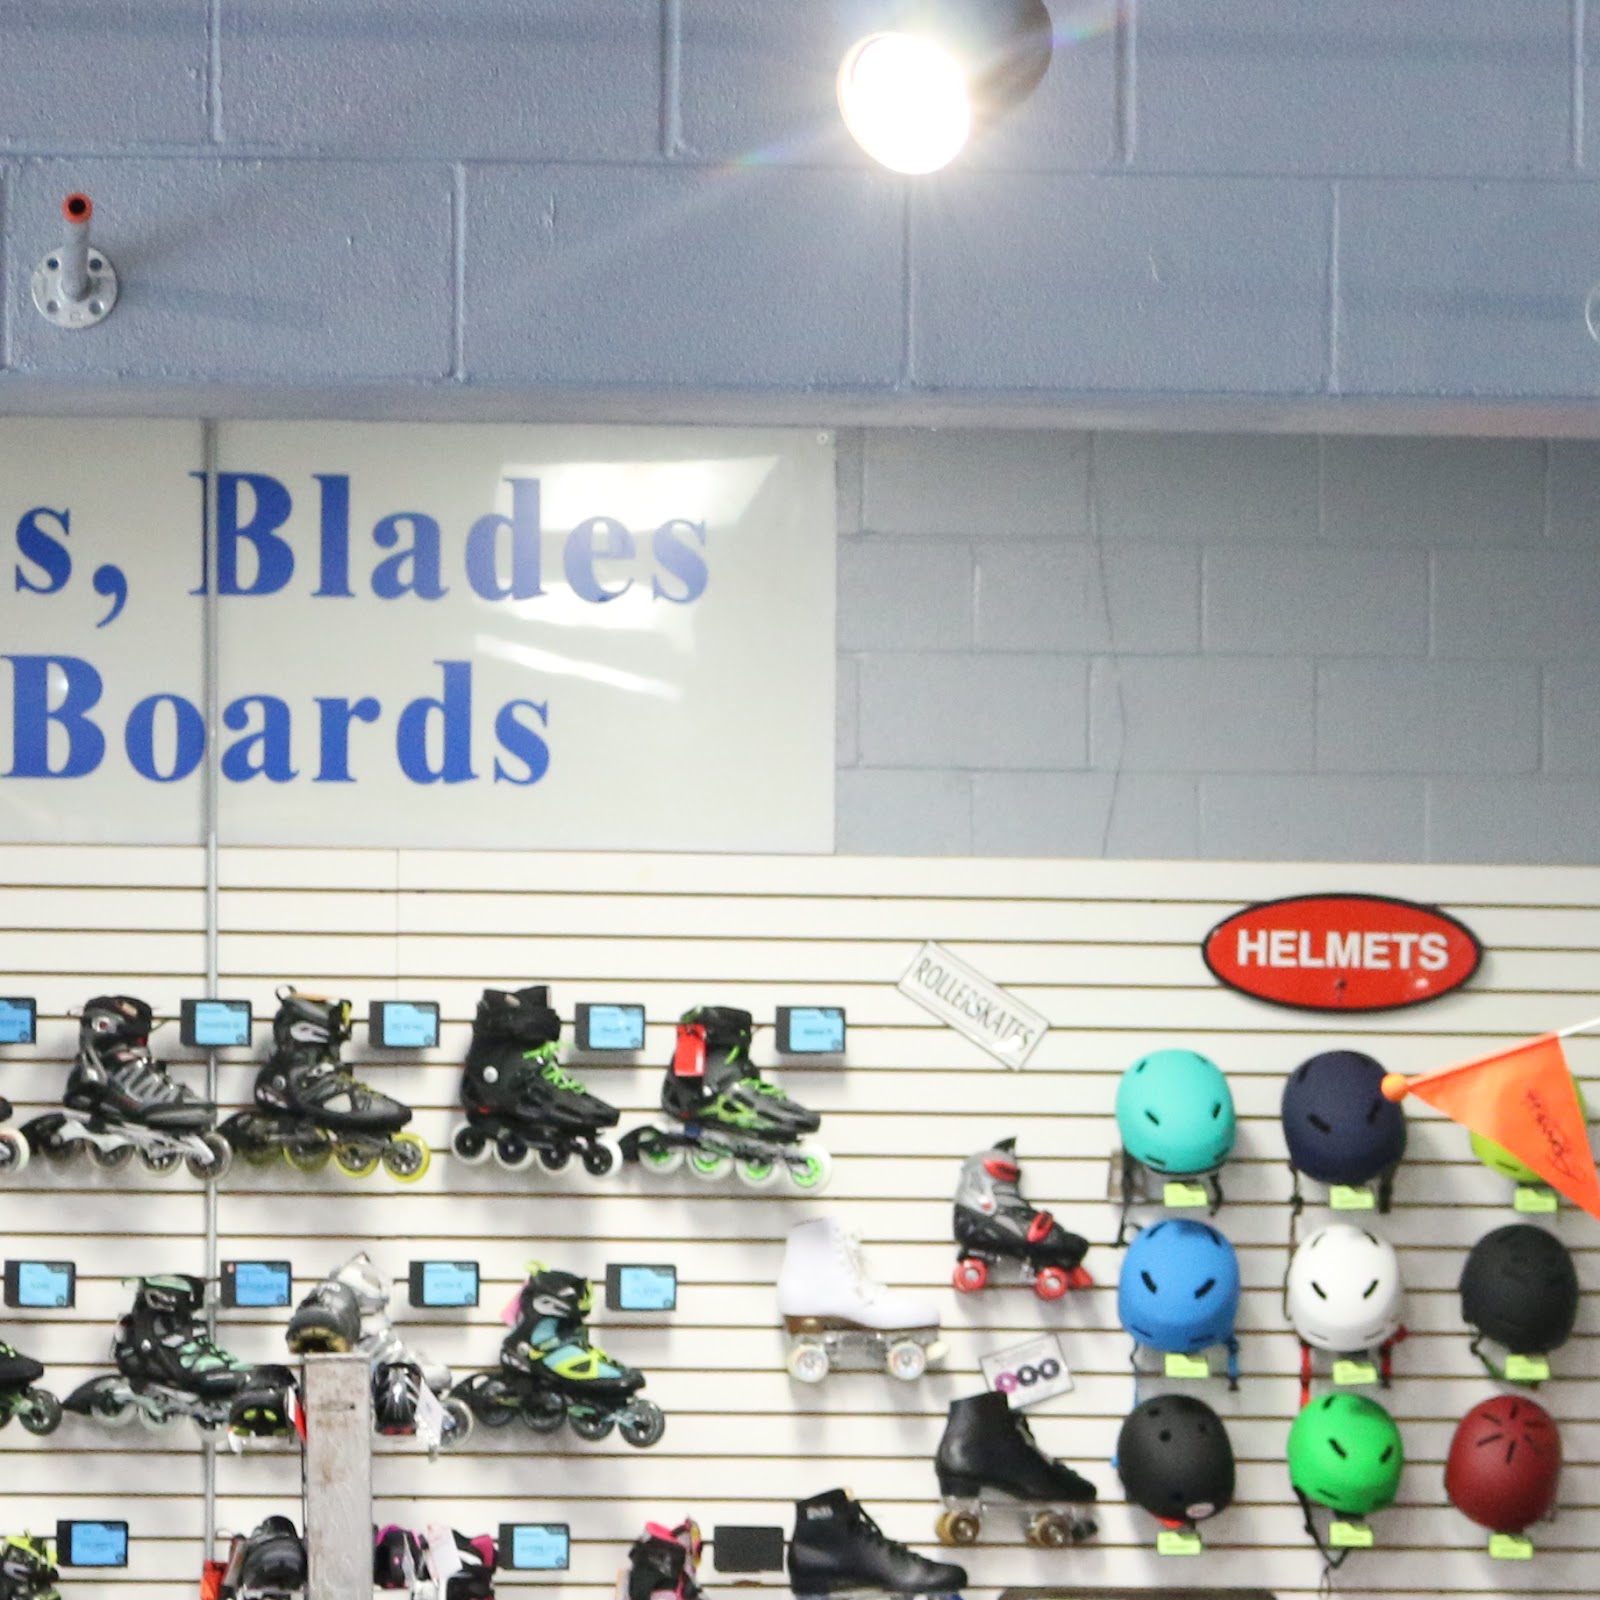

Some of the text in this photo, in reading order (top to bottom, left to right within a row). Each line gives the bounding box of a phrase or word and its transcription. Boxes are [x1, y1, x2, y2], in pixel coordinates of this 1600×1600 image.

[190, 472, 710, 607] Blades
[0, 654, 550, 786] Boards
[1236, 928, 1449, 971] HELMETS
